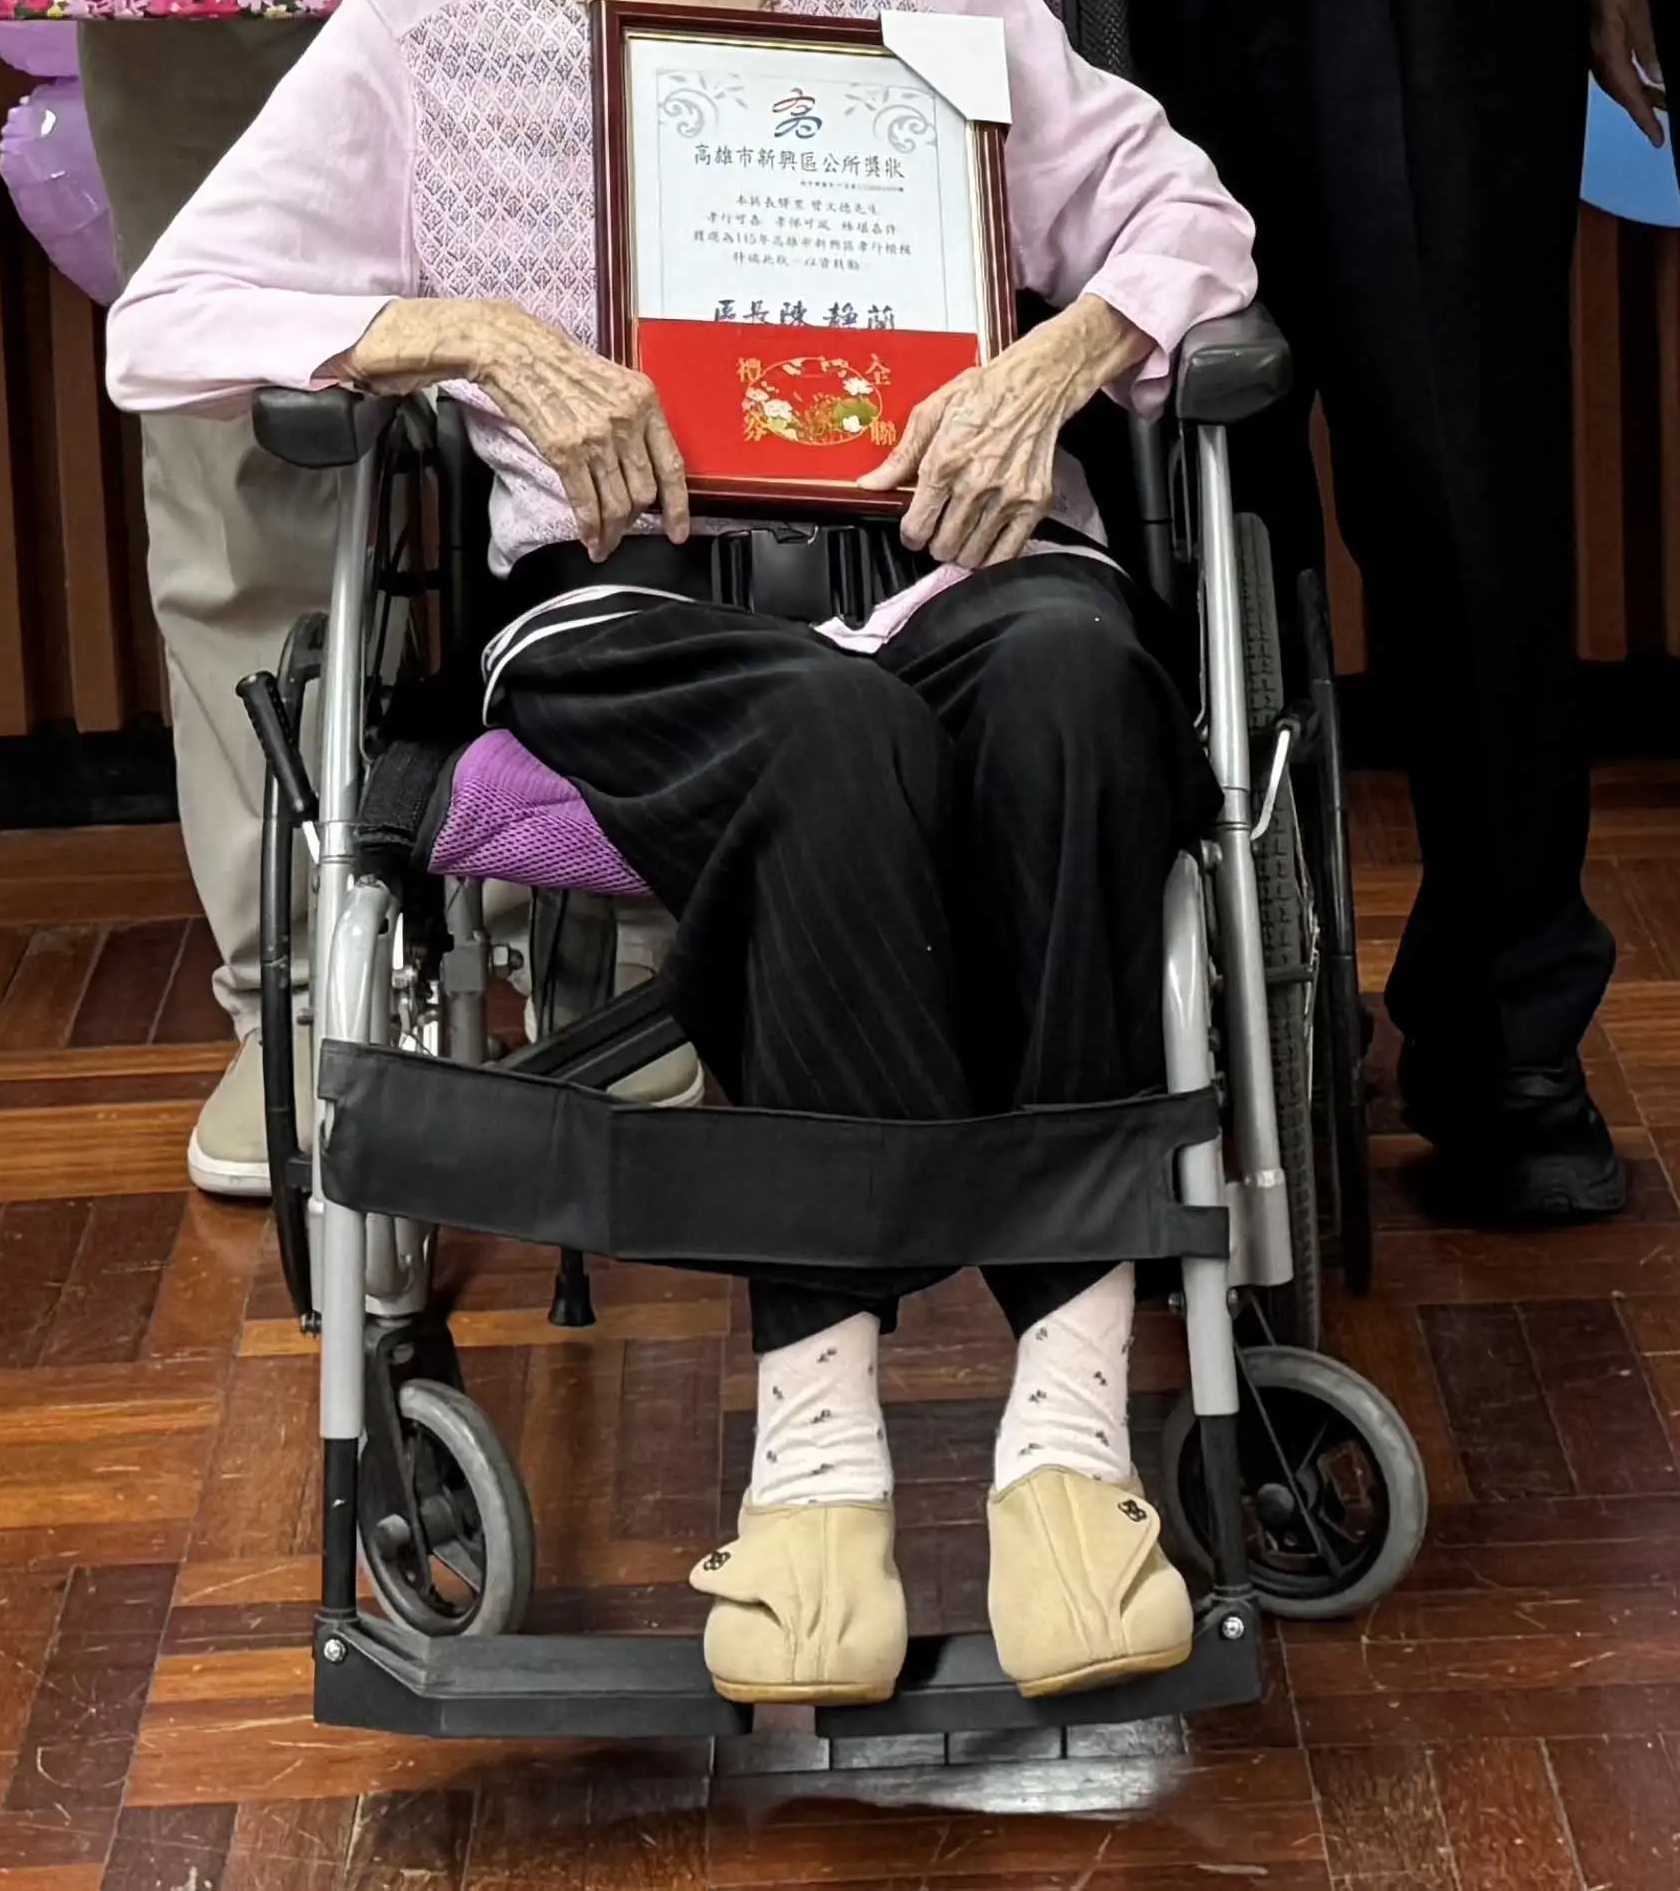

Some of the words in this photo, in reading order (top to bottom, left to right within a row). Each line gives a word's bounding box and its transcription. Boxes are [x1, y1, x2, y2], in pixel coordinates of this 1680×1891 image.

[694, 142, 906, 179] 高雄市新興區公所獎狀
